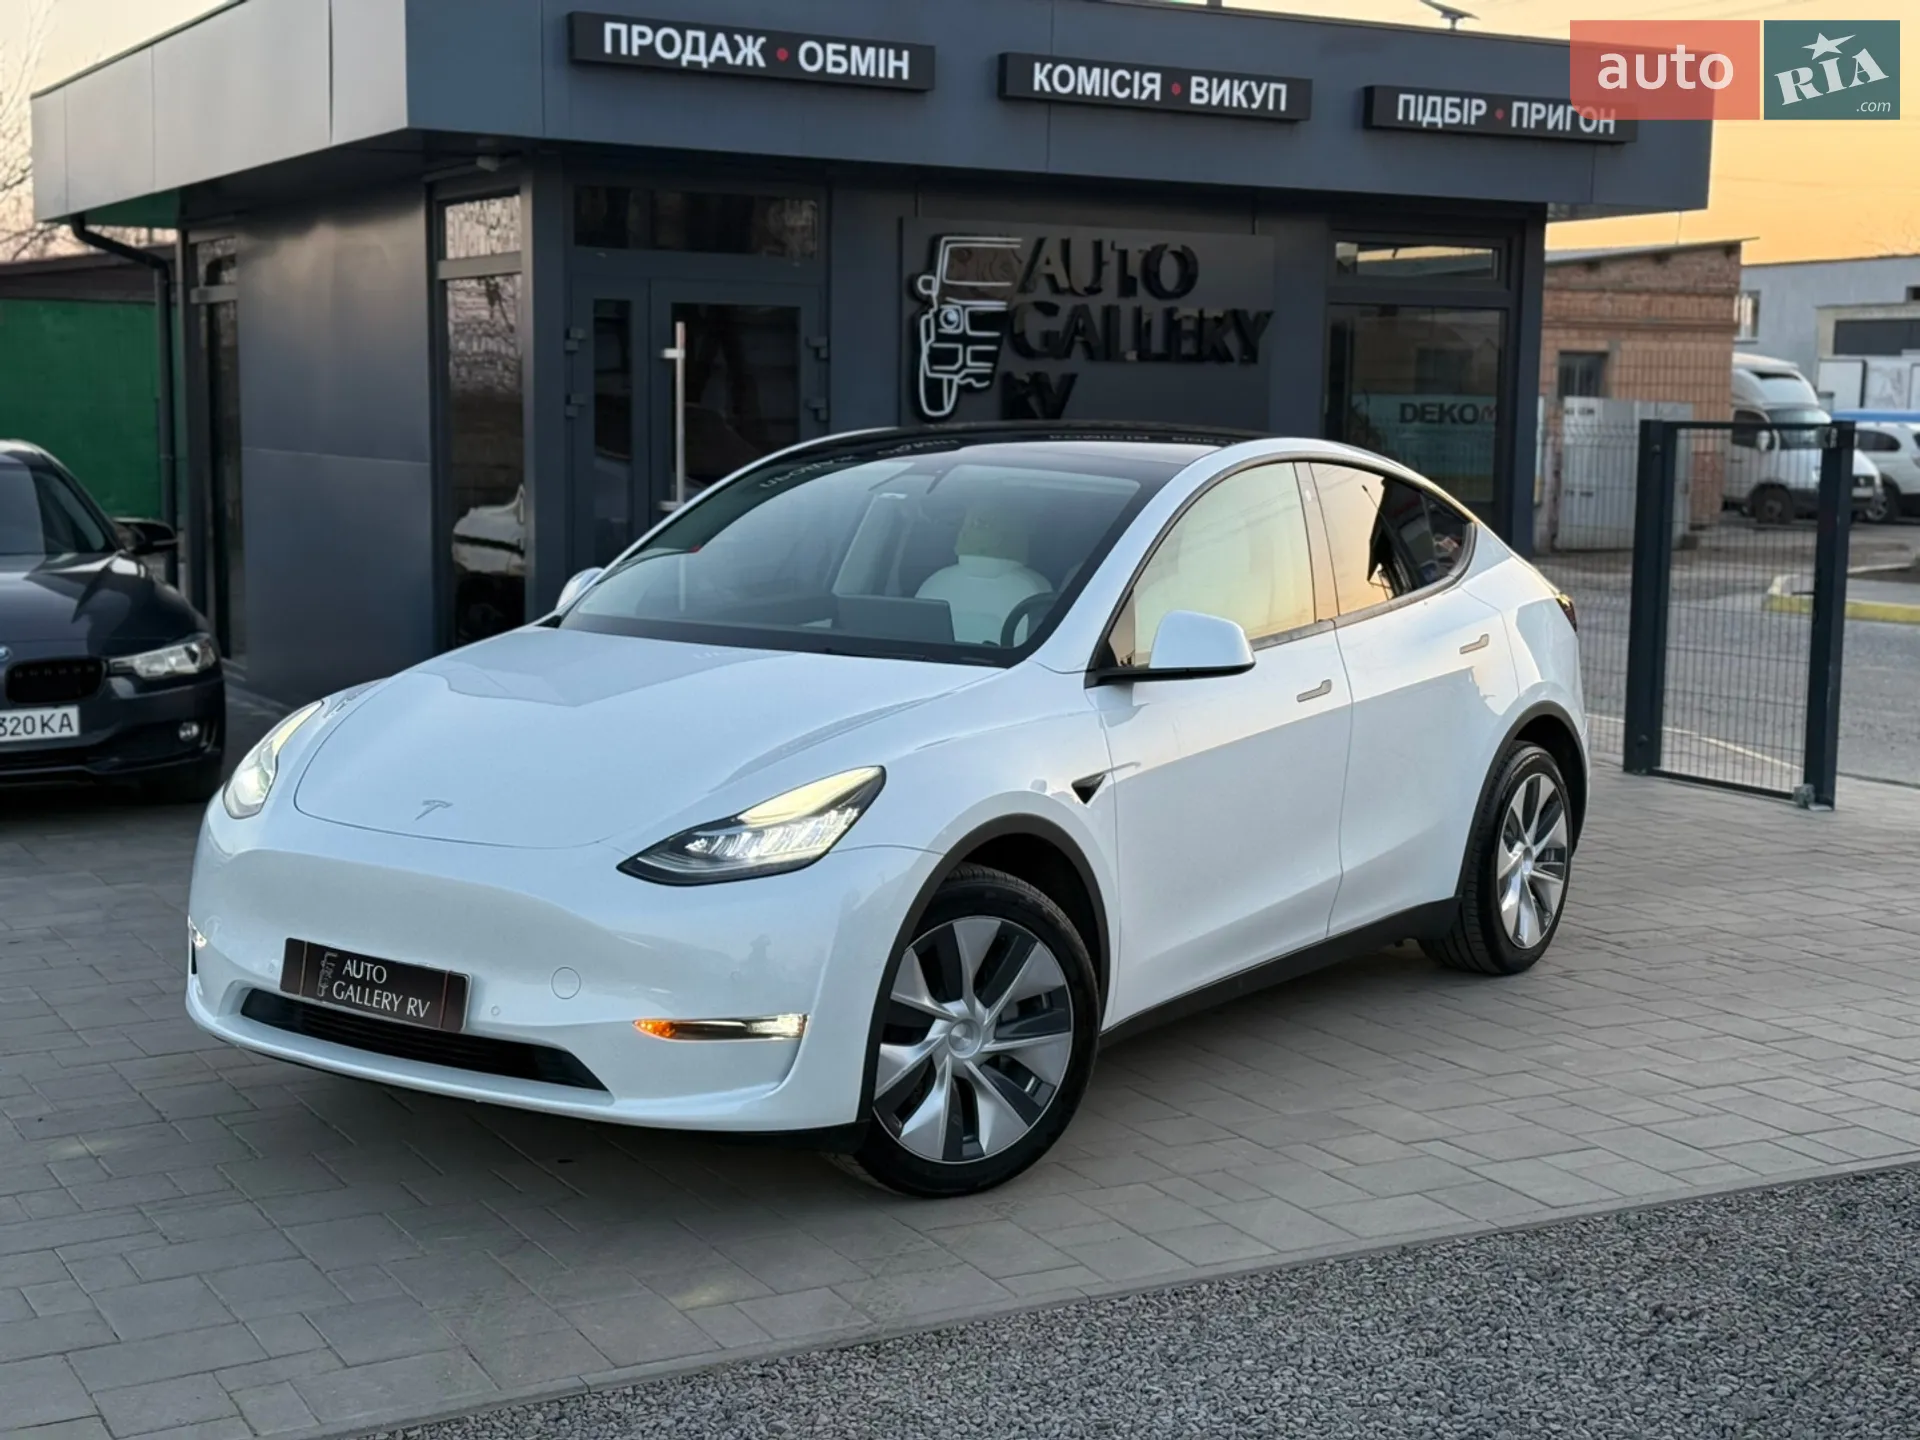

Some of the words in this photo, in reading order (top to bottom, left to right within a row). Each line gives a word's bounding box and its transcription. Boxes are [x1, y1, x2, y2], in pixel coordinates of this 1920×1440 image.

[603, 21, 767, 68] ПРОДАЖ
[798, 40, 910, 81] ОБМІН
[1032, 61, 1162, 102] КОМІСІЯ
[1189, 75, 1288, 112] ВИКУП
[1397, 93, 1487, 129] ПІДБІР
[1510, 101, 1617, 134] ПРИГОН
[1015, 236, 1200, 300] AUTO
[342, 959, 387, 984] AUTO
[332, 980, 403, 1012] GALLERY
[406, 997, 430, 1018] RV
